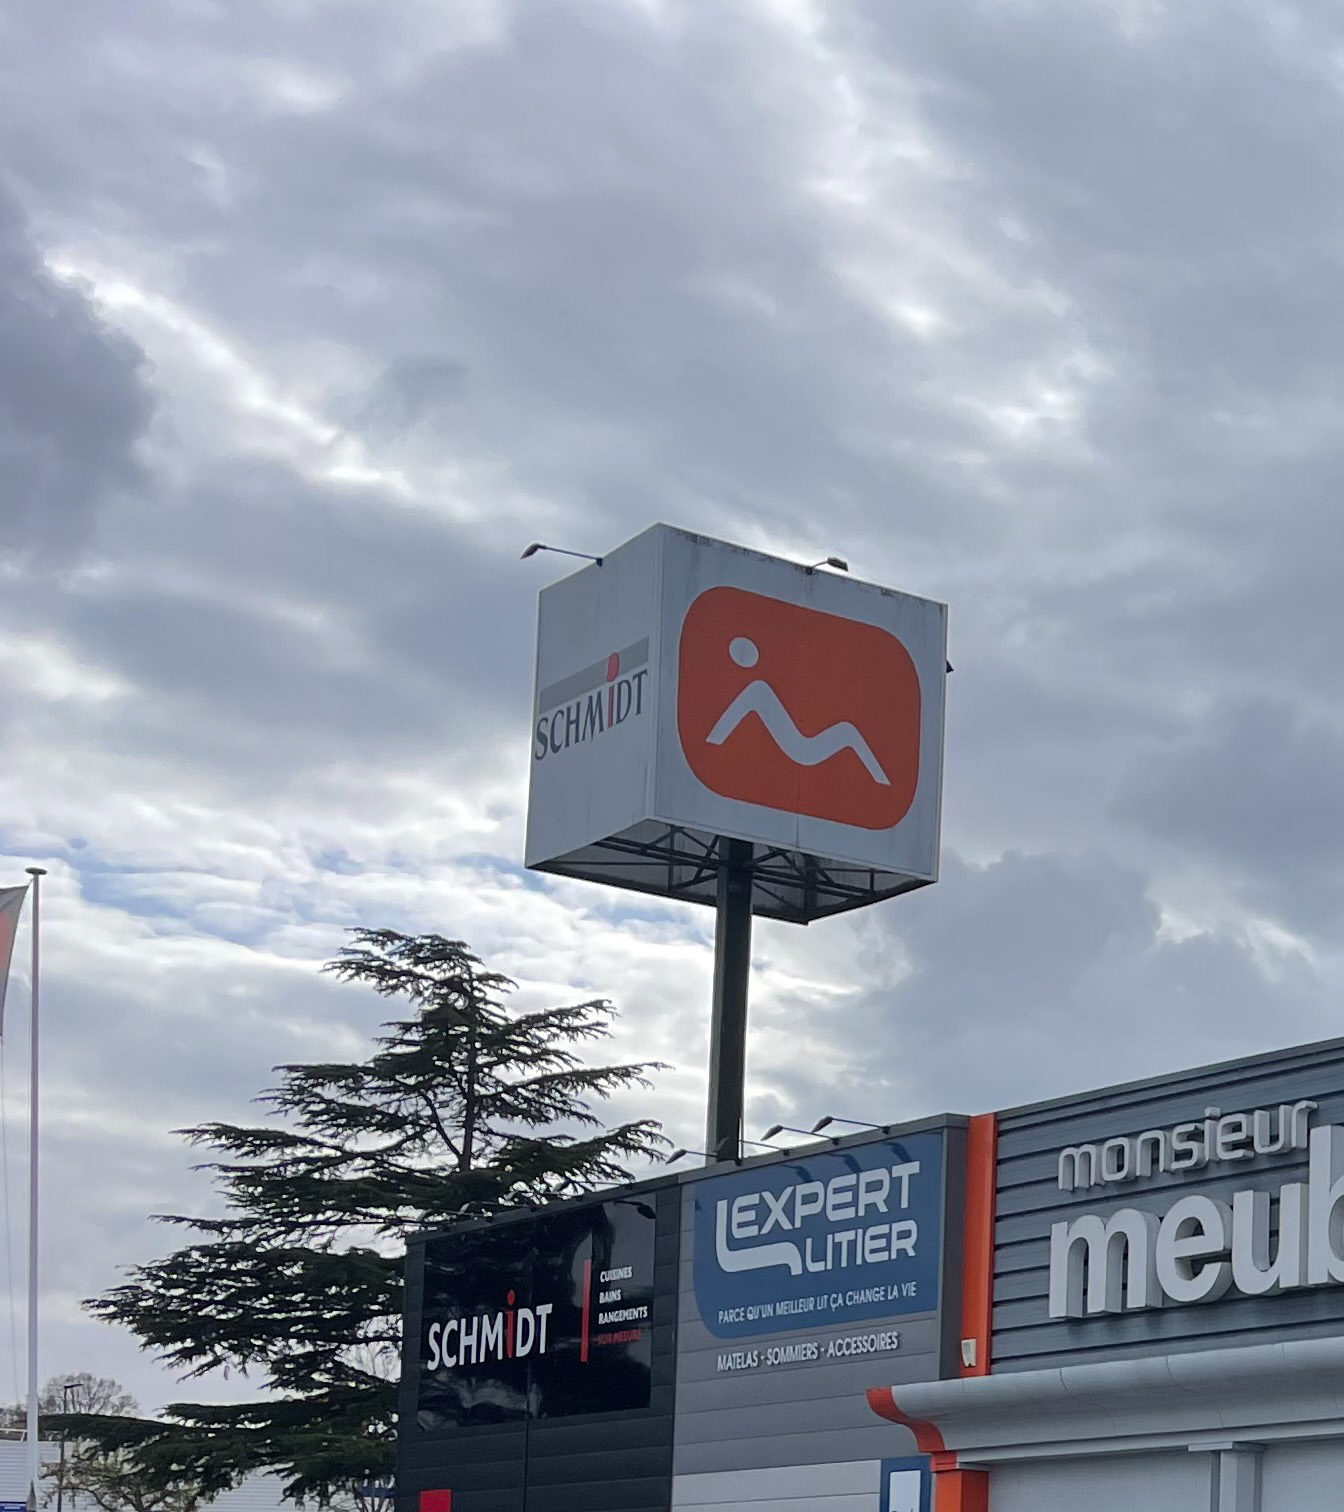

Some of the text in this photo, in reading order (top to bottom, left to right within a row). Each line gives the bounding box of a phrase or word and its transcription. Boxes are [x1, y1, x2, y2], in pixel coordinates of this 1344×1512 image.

[1058, 1100, 1318, 1191] monsieur
[808, 1220, 918, 1273] LITIER
[600, 1266, 632, 1282] CUISINES
[598, 1306, 648, 1324] RANGEMENTS
[599, 1289, 621, 1304] BAINS
[718, 1281, 917, 1324] PARCE QU'UN MEILLEUR LIT ÇA CHANGE LA VIE
[717, 1332, 898, 1371] MATELAS SOMMIERS ACCESSOIRES
